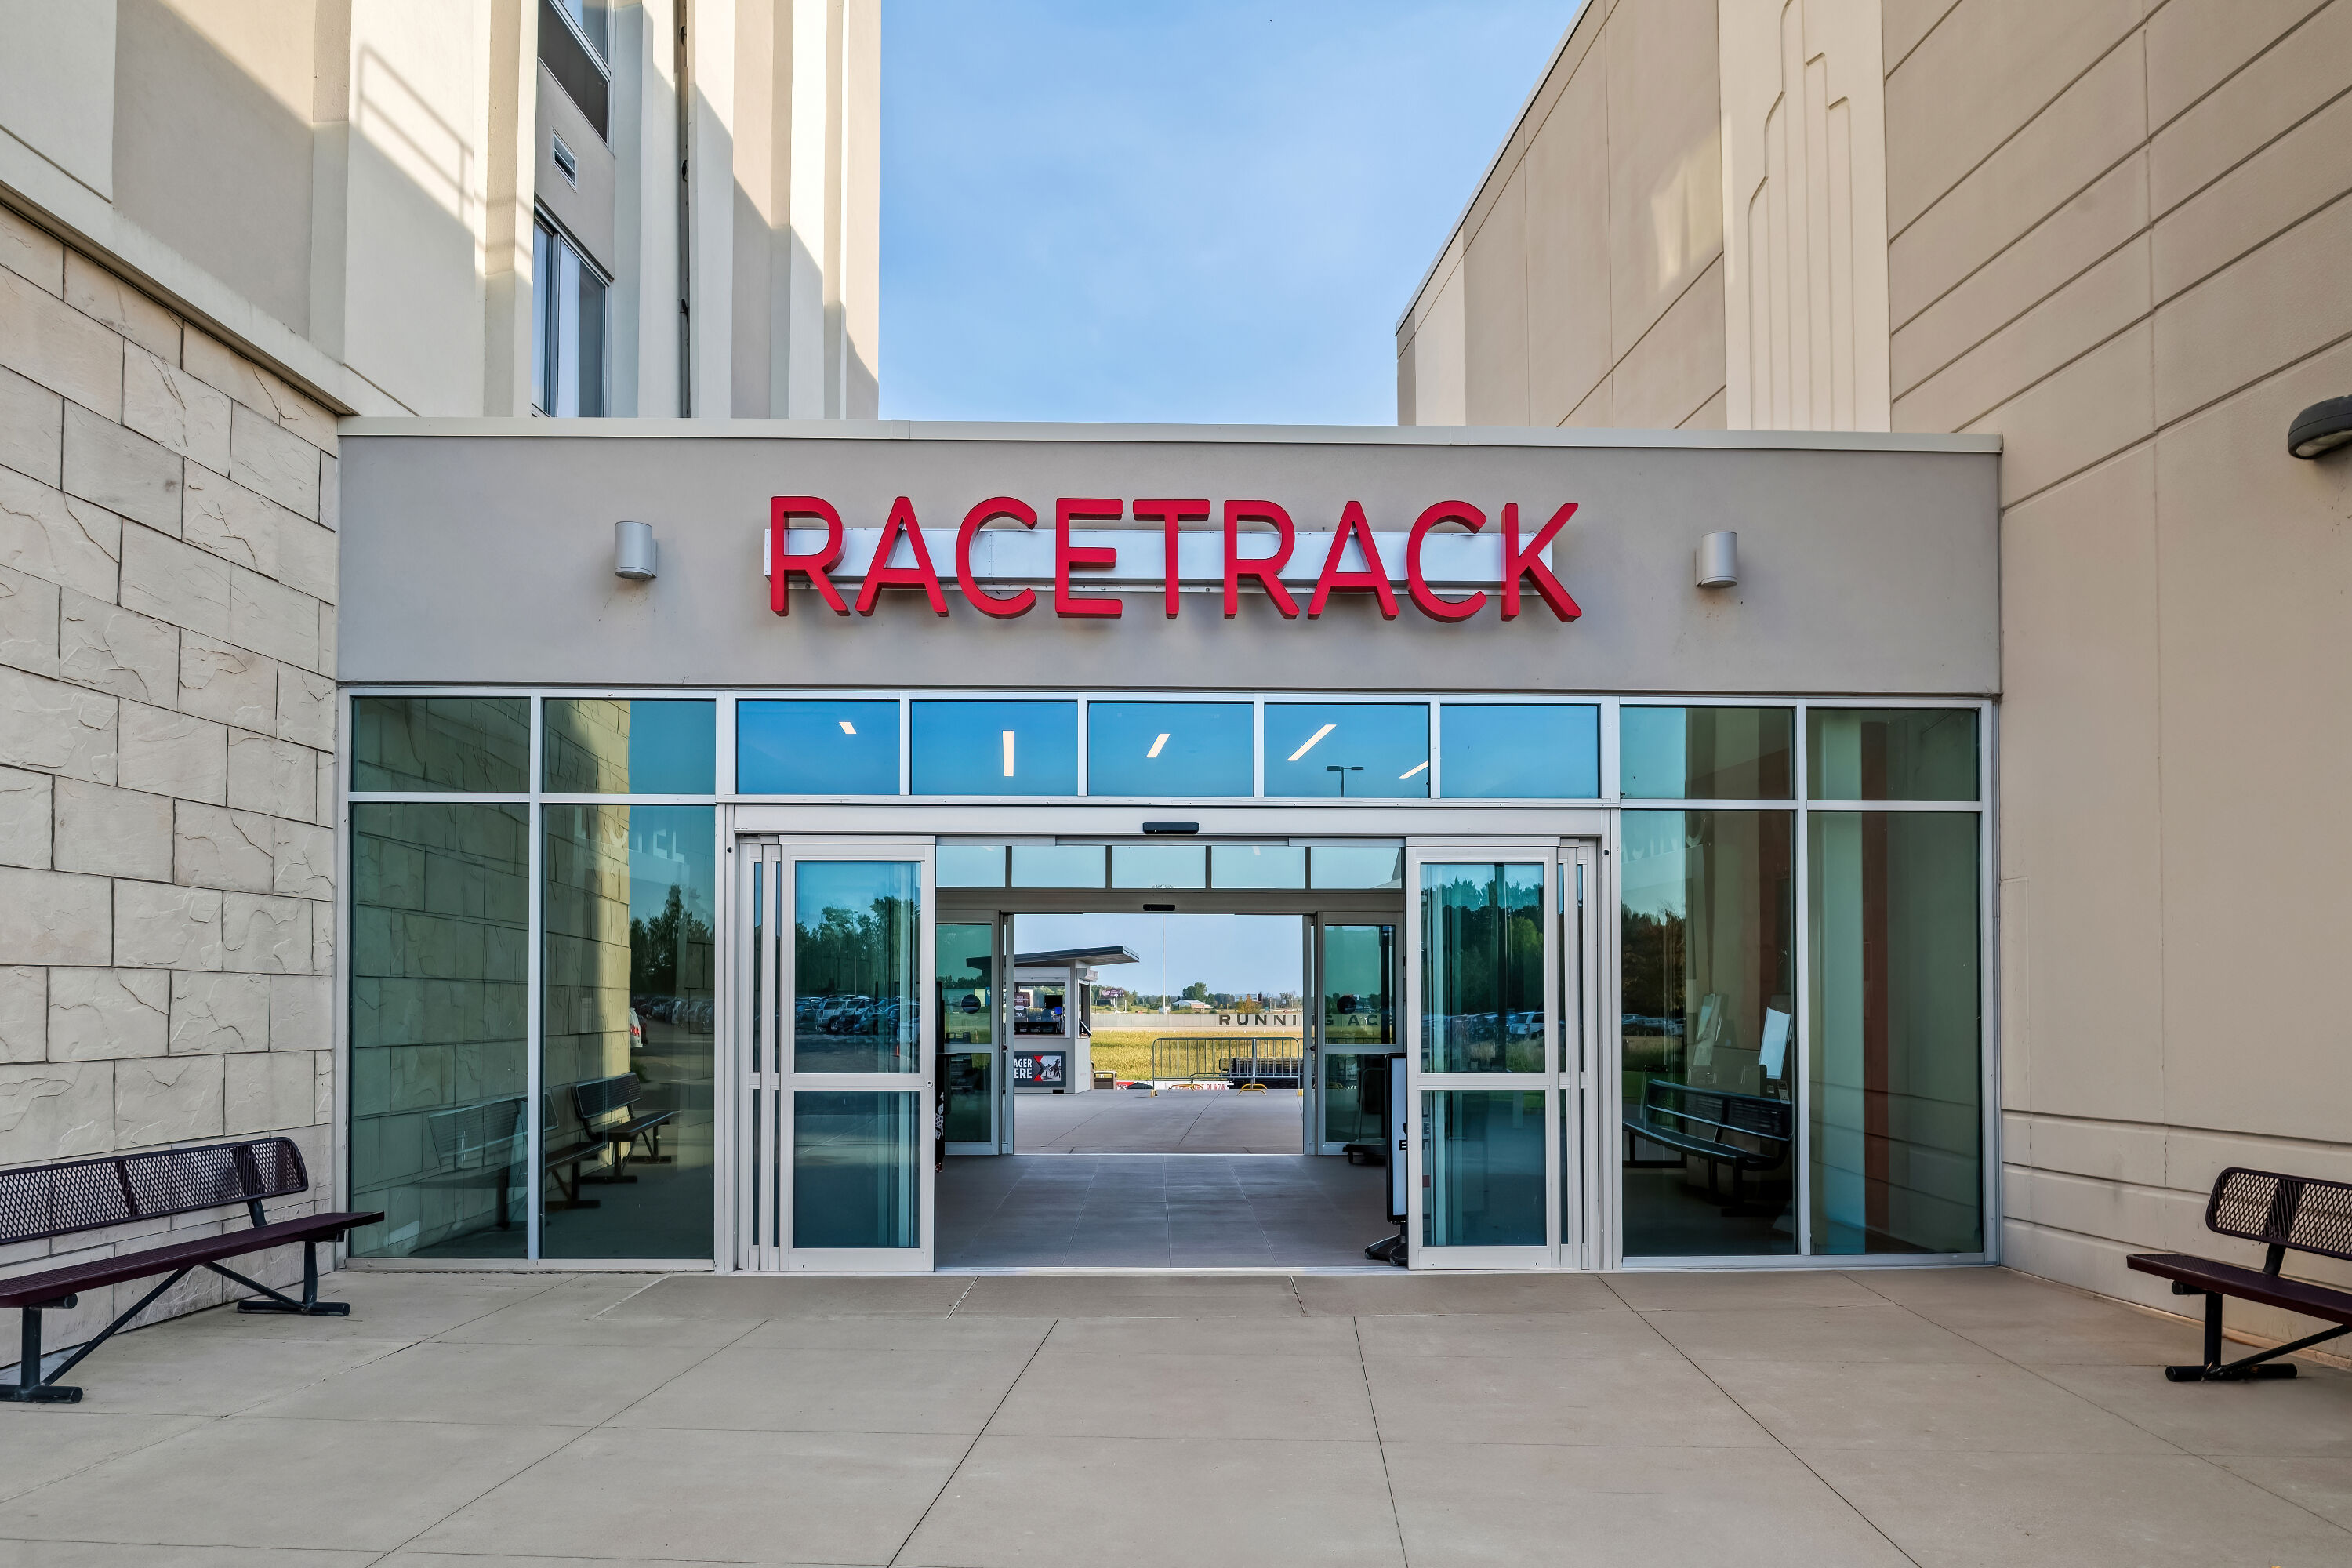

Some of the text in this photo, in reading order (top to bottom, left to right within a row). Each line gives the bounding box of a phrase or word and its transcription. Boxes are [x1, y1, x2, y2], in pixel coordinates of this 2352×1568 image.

[769, 496, 1582, 622] RACETRACK
[1218, 1014, 1334, 1027] RUNNIG
[1013, 1058, 1033, 1068] AGER
[1014, 1068, 1033, 1079] ERE
